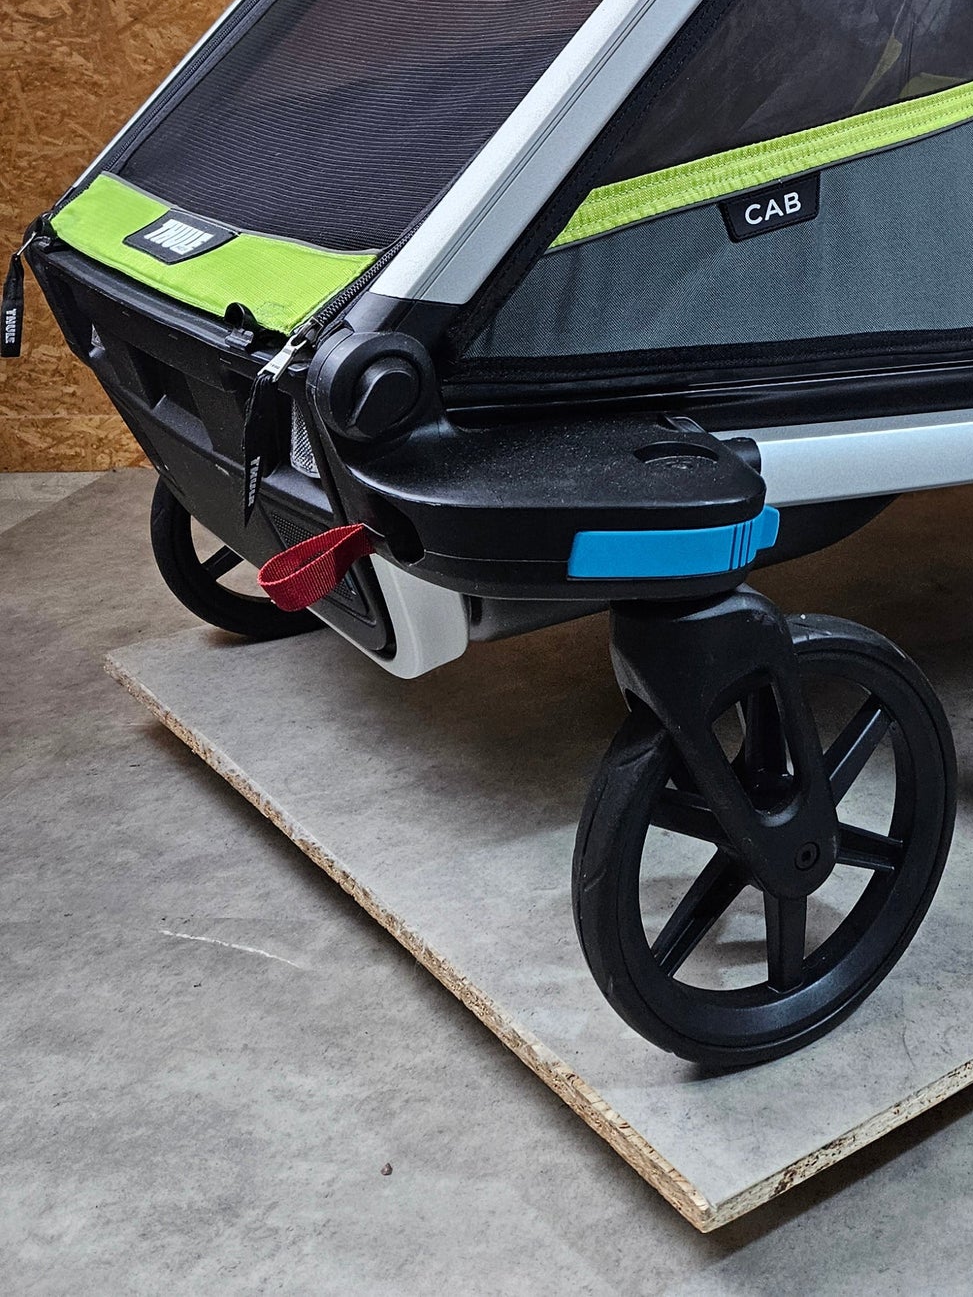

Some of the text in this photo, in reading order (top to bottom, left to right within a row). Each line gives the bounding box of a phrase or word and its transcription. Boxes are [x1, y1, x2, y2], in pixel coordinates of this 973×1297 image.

[744, 191, 802, 225] CAB
[143, 218, 215, 256] THULE
[5, 308, 17, 344] THULE
[248, 455, 261, 507] THULE
